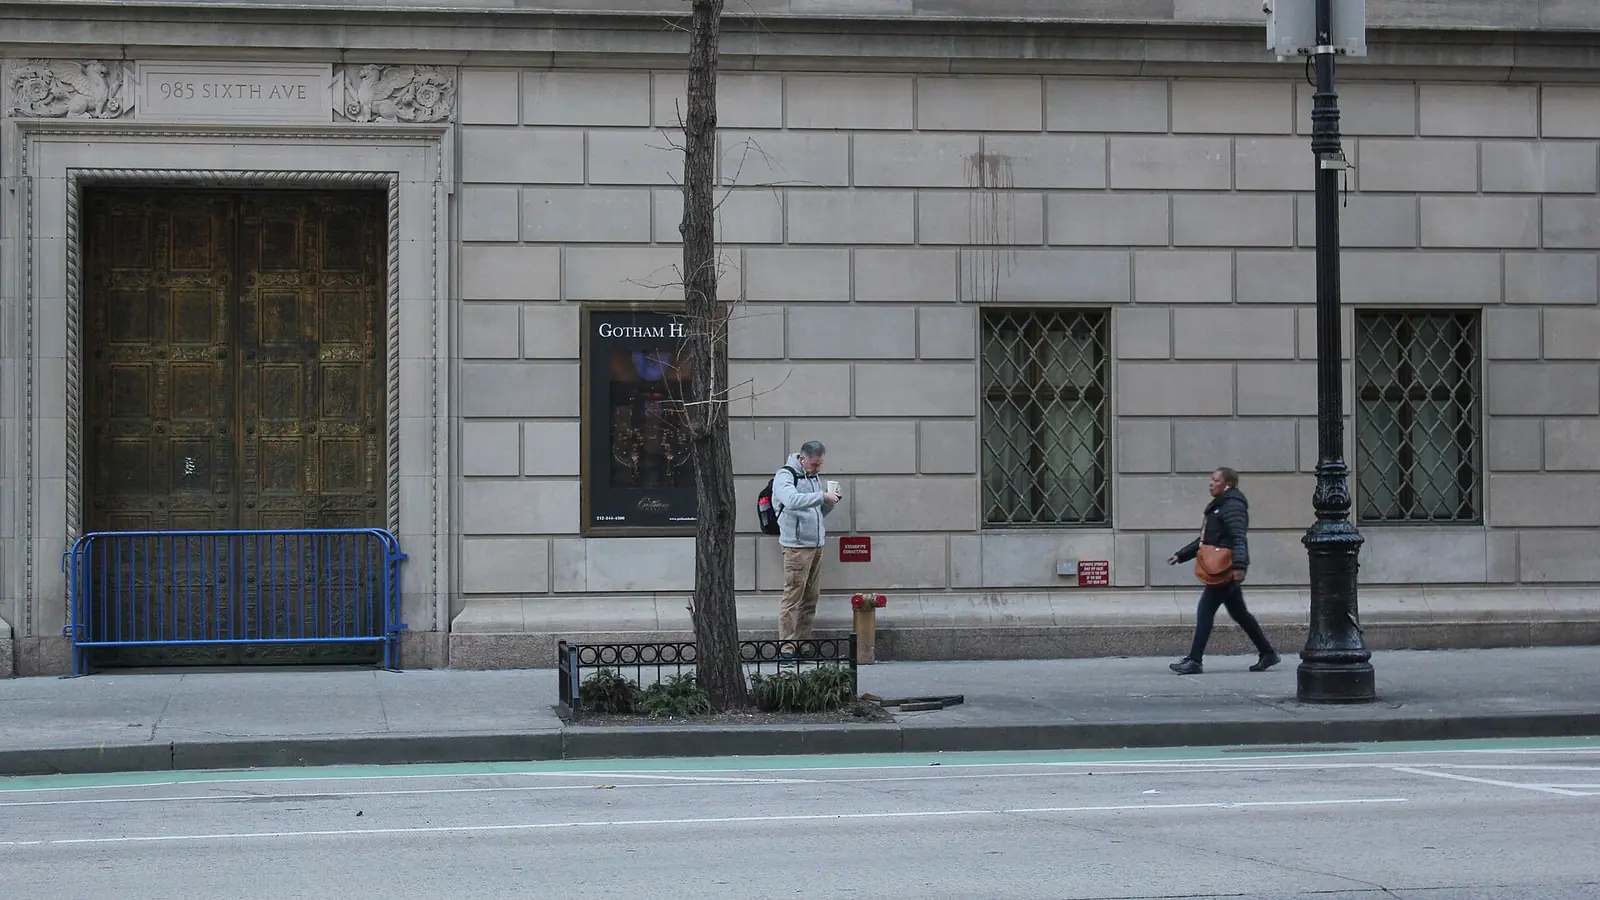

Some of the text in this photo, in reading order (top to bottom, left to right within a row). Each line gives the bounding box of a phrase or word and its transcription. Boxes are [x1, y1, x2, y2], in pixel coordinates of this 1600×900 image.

[160, 82, 306, 99] 985 SIXTH AVE
